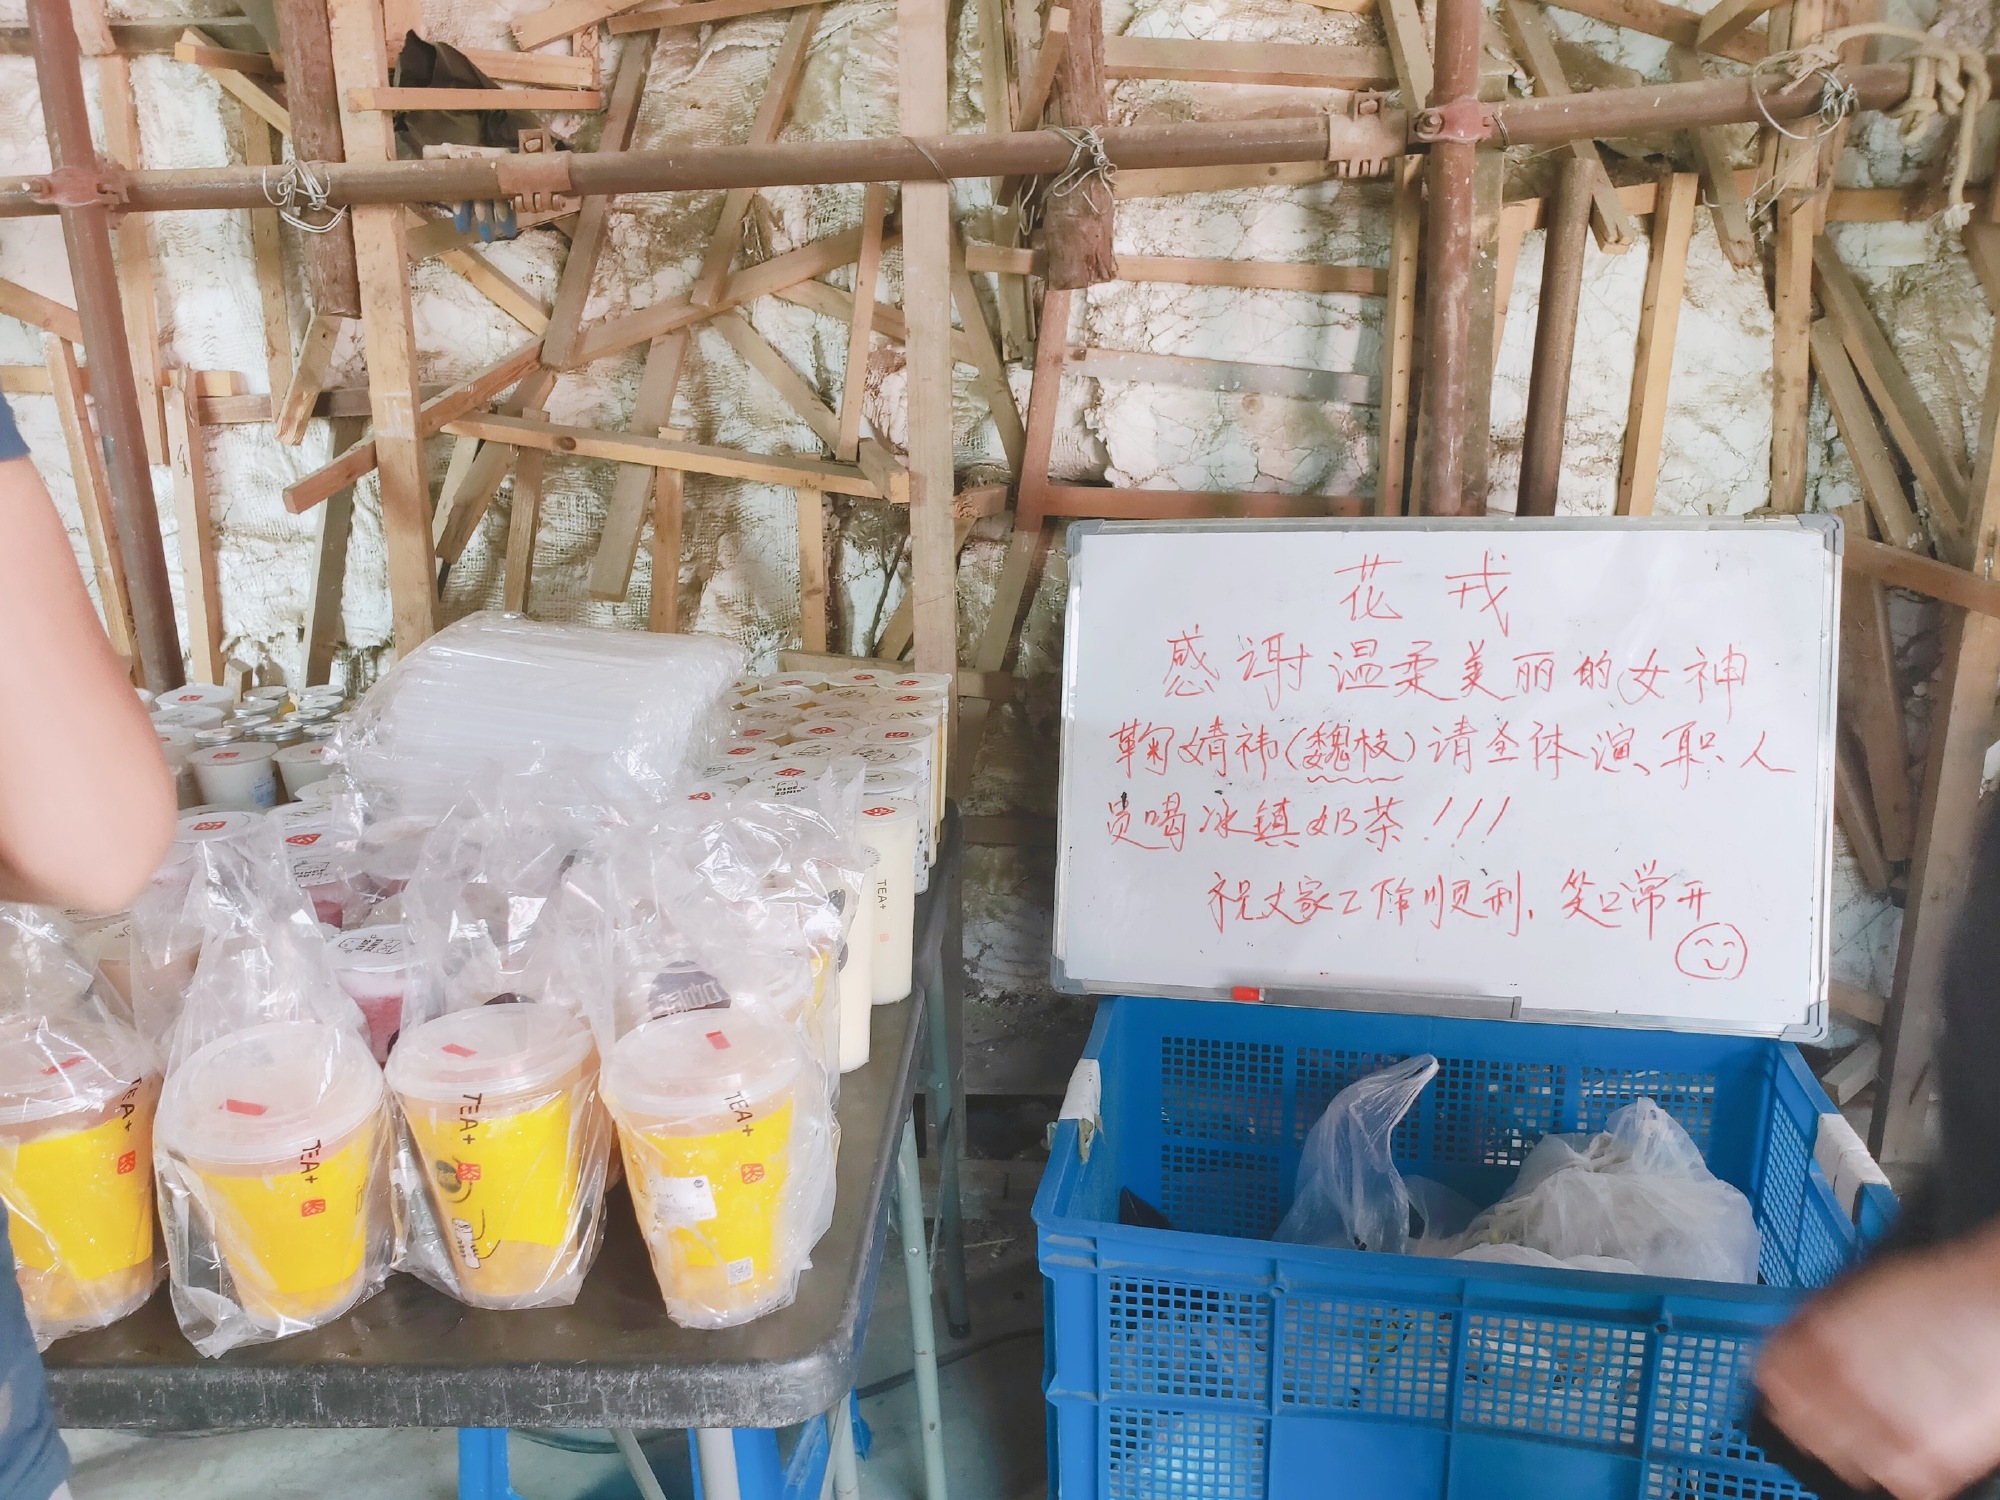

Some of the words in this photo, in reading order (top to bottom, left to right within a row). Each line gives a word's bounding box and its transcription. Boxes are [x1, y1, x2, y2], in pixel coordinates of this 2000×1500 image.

[1164, 624, 1748, 720] 感谢温柔美丽的女神
[876, 878, 887, 911] TEA+
[119, 1075, 142, 1133] TEA+
[458, 1092, 483, 1146] TEA+
[722, 1089, 756, 1138] TEA+
[299, 1138, 323, 1185] TEA+
